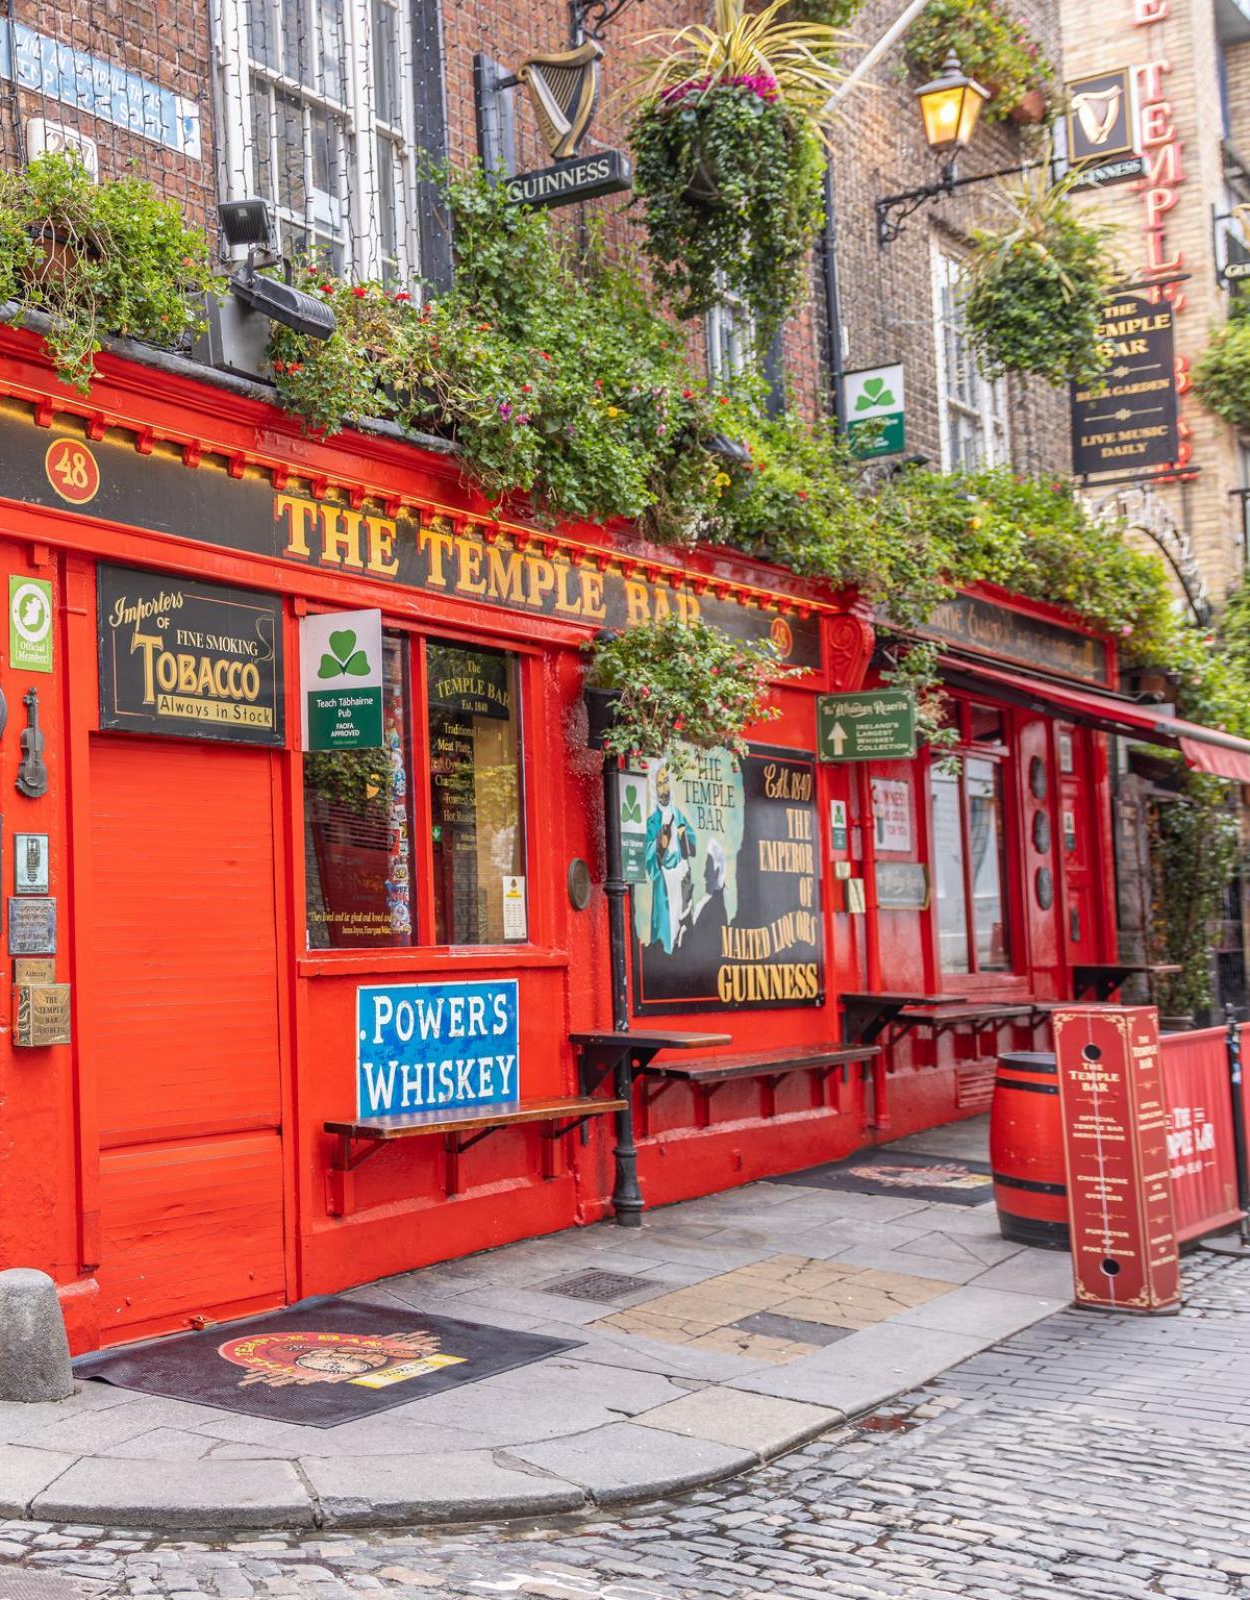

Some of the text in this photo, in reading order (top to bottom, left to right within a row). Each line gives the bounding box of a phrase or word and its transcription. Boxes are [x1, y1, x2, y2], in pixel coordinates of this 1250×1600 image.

[506, 159, 610, 202] GUINNESS
[1102, 302, 1138, 319] THE
[1094, 313, 1171, 338] EMPLE
[1113, 378, 1171, 396] GARDEN
[1081, 424, 1169, 447] LIVE MUSIC
[1101, 442, 1149, 459] DAILY
[54, 448, 88, 489] 48
[277, 494, 702, 628] THE TEMPLE BAR
[109, 591, 184, 632] Importers
[157, 617, 171, 630] OF
[20, 641, 46, 652] Official
[176, 629, 260, 656] FINE SMOKING
[18, 650, 48, 664] Member
[130, 632, 261, 705] TOBACCO
[467, 659, 481, 675] The
[316, 698, 337, 708] Teach
[435, 677, 511, 707] TEMPLE BAR
[160, 696, 271, 725] Always in Stock
[337, 708, 352, 718] Pub
[330, 729, 360, 738] APPROVED
[856, 737, 895, 745] WHISKEY
[856, 743, 909, 752] COLLECTION
[695, 754, 723, 782] THE
[682, 779, 736, 809] TEMPLE
[697, 806, 726, 834] BAR
[785, 807, 813, 840] THE
[758, 839, 815, 875] EMPEROR
[799, 877, 815, 908] OF
[721, 910, 818, 961] MALTED LIQUORS
[717, 963, 819, 1003] GUINNESS
[1067, 1070, 1120, 1083] TEMPLE
[1081, 1062, 1104, 1072] THE
[362, 1054, 516, 1112] WHISKEY
[1081, 1082, 1109, 1093] BAR
[1106, 1124, 1124, 1132] BAR
